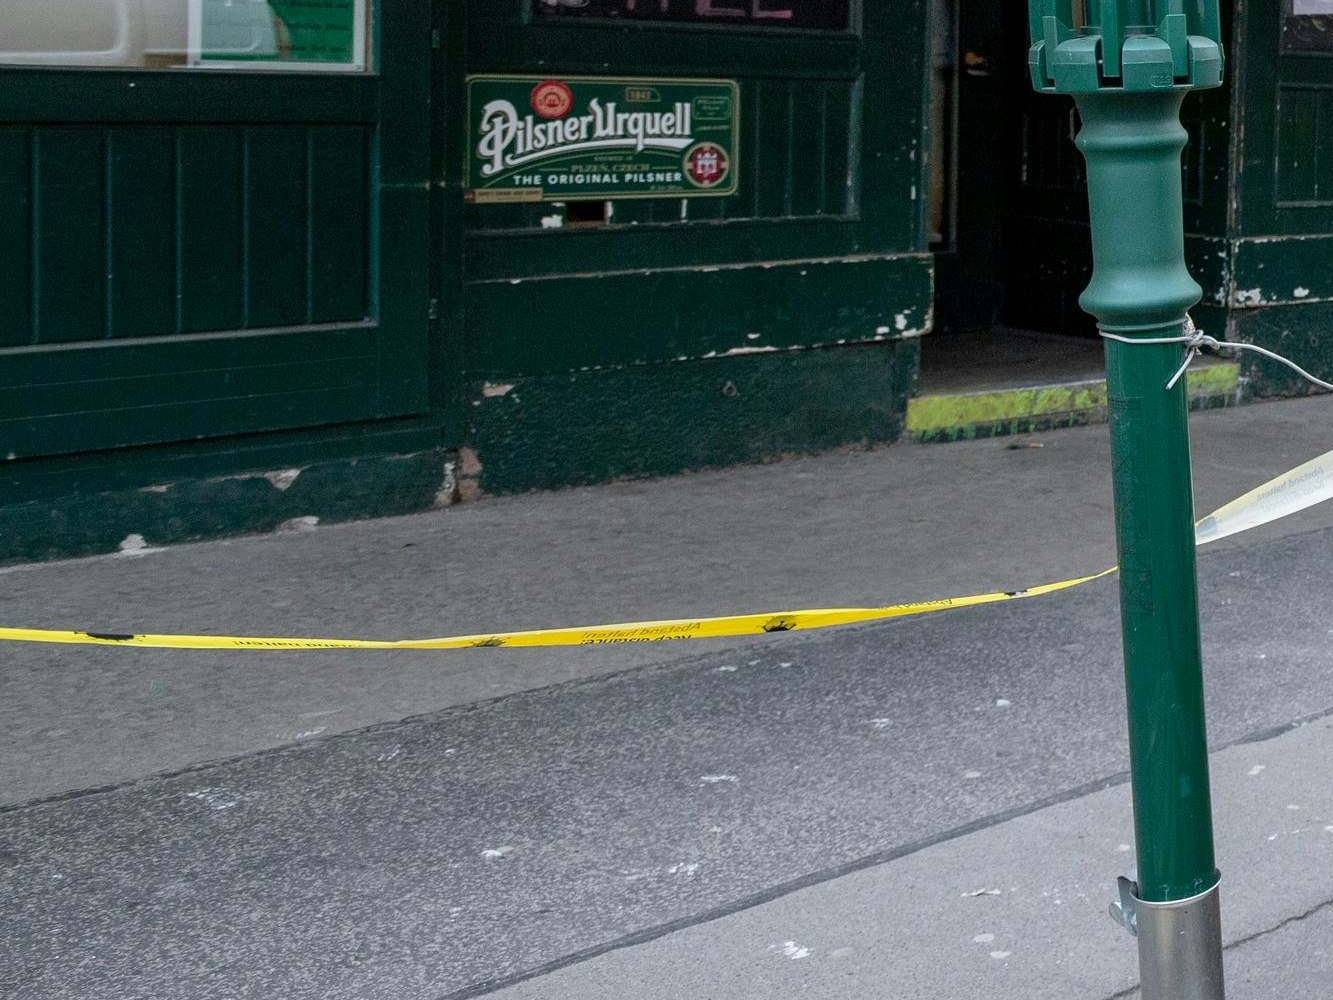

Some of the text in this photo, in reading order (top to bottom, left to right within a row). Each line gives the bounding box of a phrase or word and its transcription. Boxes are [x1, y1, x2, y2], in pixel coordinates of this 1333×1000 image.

[478, 99, 594, 176] Pilsner
[590, 98, 692, 153] Urquell
[513, 172, 682, 185] THE ORIGINAL PILSNER
